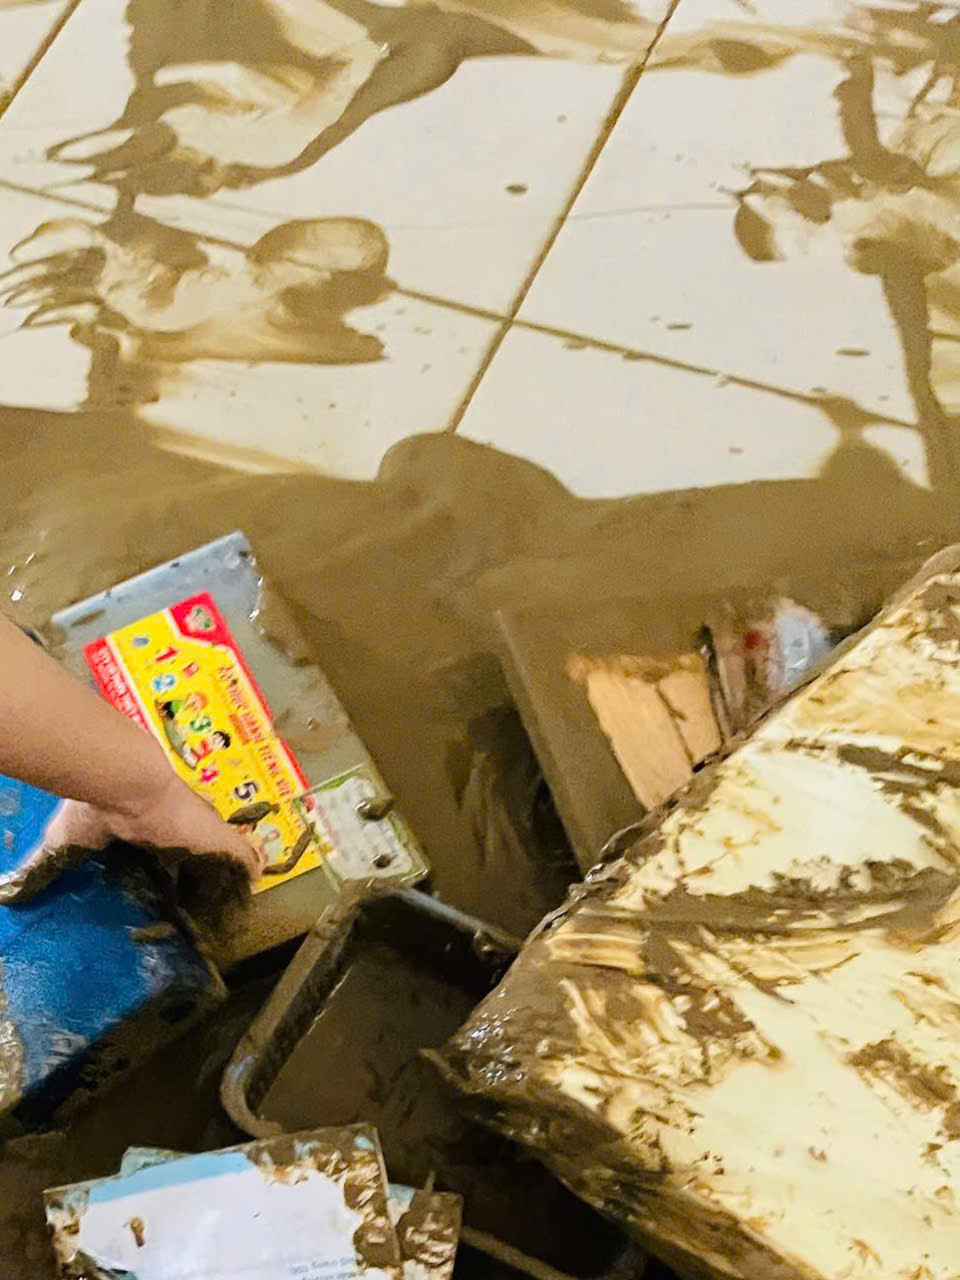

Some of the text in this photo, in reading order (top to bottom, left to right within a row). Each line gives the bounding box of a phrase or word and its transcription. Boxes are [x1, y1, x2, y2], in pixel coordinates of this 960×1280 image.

[156, 647, 179, 662] 1
[191, 714, 211, 731] 3
[201, 768, 219, 781] 4
[234, 782, 257, 799] 5
